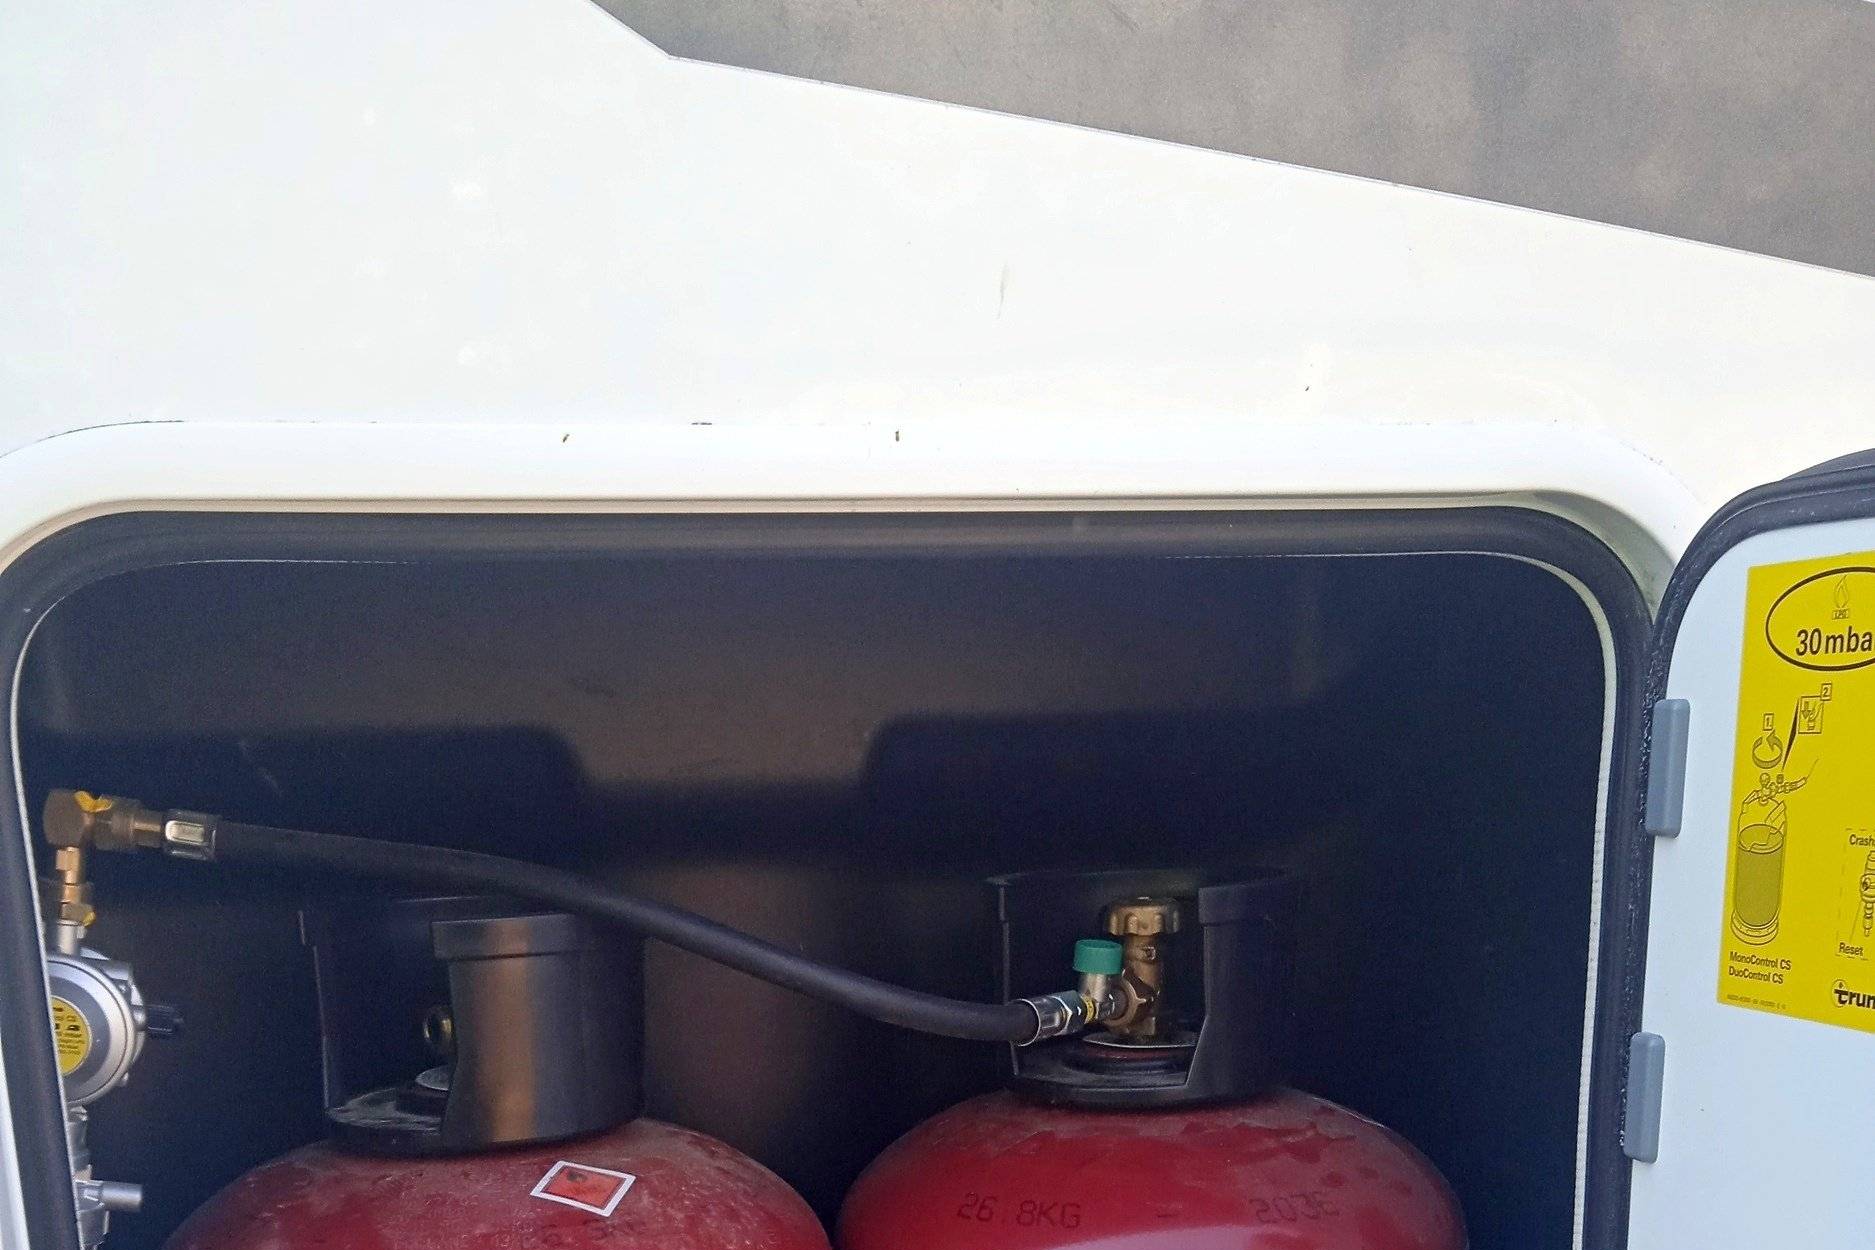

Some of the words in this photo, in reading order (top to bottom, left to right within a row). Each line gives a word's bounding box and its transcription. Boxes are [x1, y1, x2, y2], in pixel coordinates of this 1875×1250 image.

[1795, 627, 1822, 656] 30
[1824, 625, 1874, 655] mba
[1839, 942, 1864, 957] Reset
[1729, 951, 1778, 969] MonoControl
[1779, 958, 1791, 971] CS
[1728, 965, 1771, 983] DuoControl
[1772, 972, 1784, 985] CS
